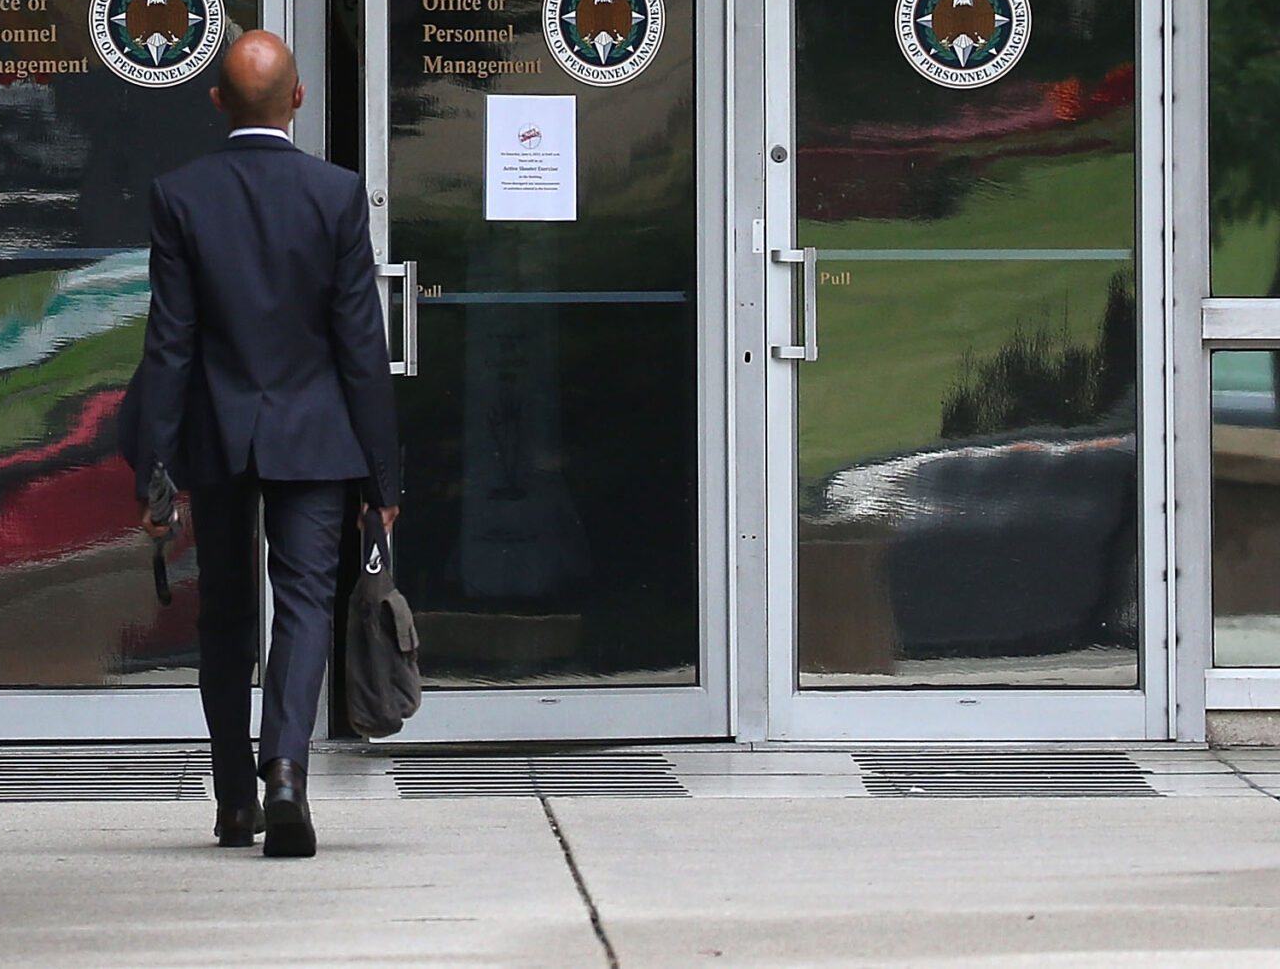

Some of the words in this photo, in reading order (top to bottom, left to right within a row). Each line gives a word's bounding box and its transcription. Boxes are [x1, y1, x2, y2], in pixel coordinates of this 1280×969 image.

[423, 24, 513, 42] Personnel
[101, 42, 116, 58] OF
[114, 56, 185, 81] PERSONNEL
[423, 56, 542, 78] Management
[553, 40, 567, 56] OF
[566, 55, 629, 80] PERSONNEL
[908, 43, 922, 58] OF
[920, 59, 991, 82] PERSONNEL
[820, 272, 850, 285] Pull
